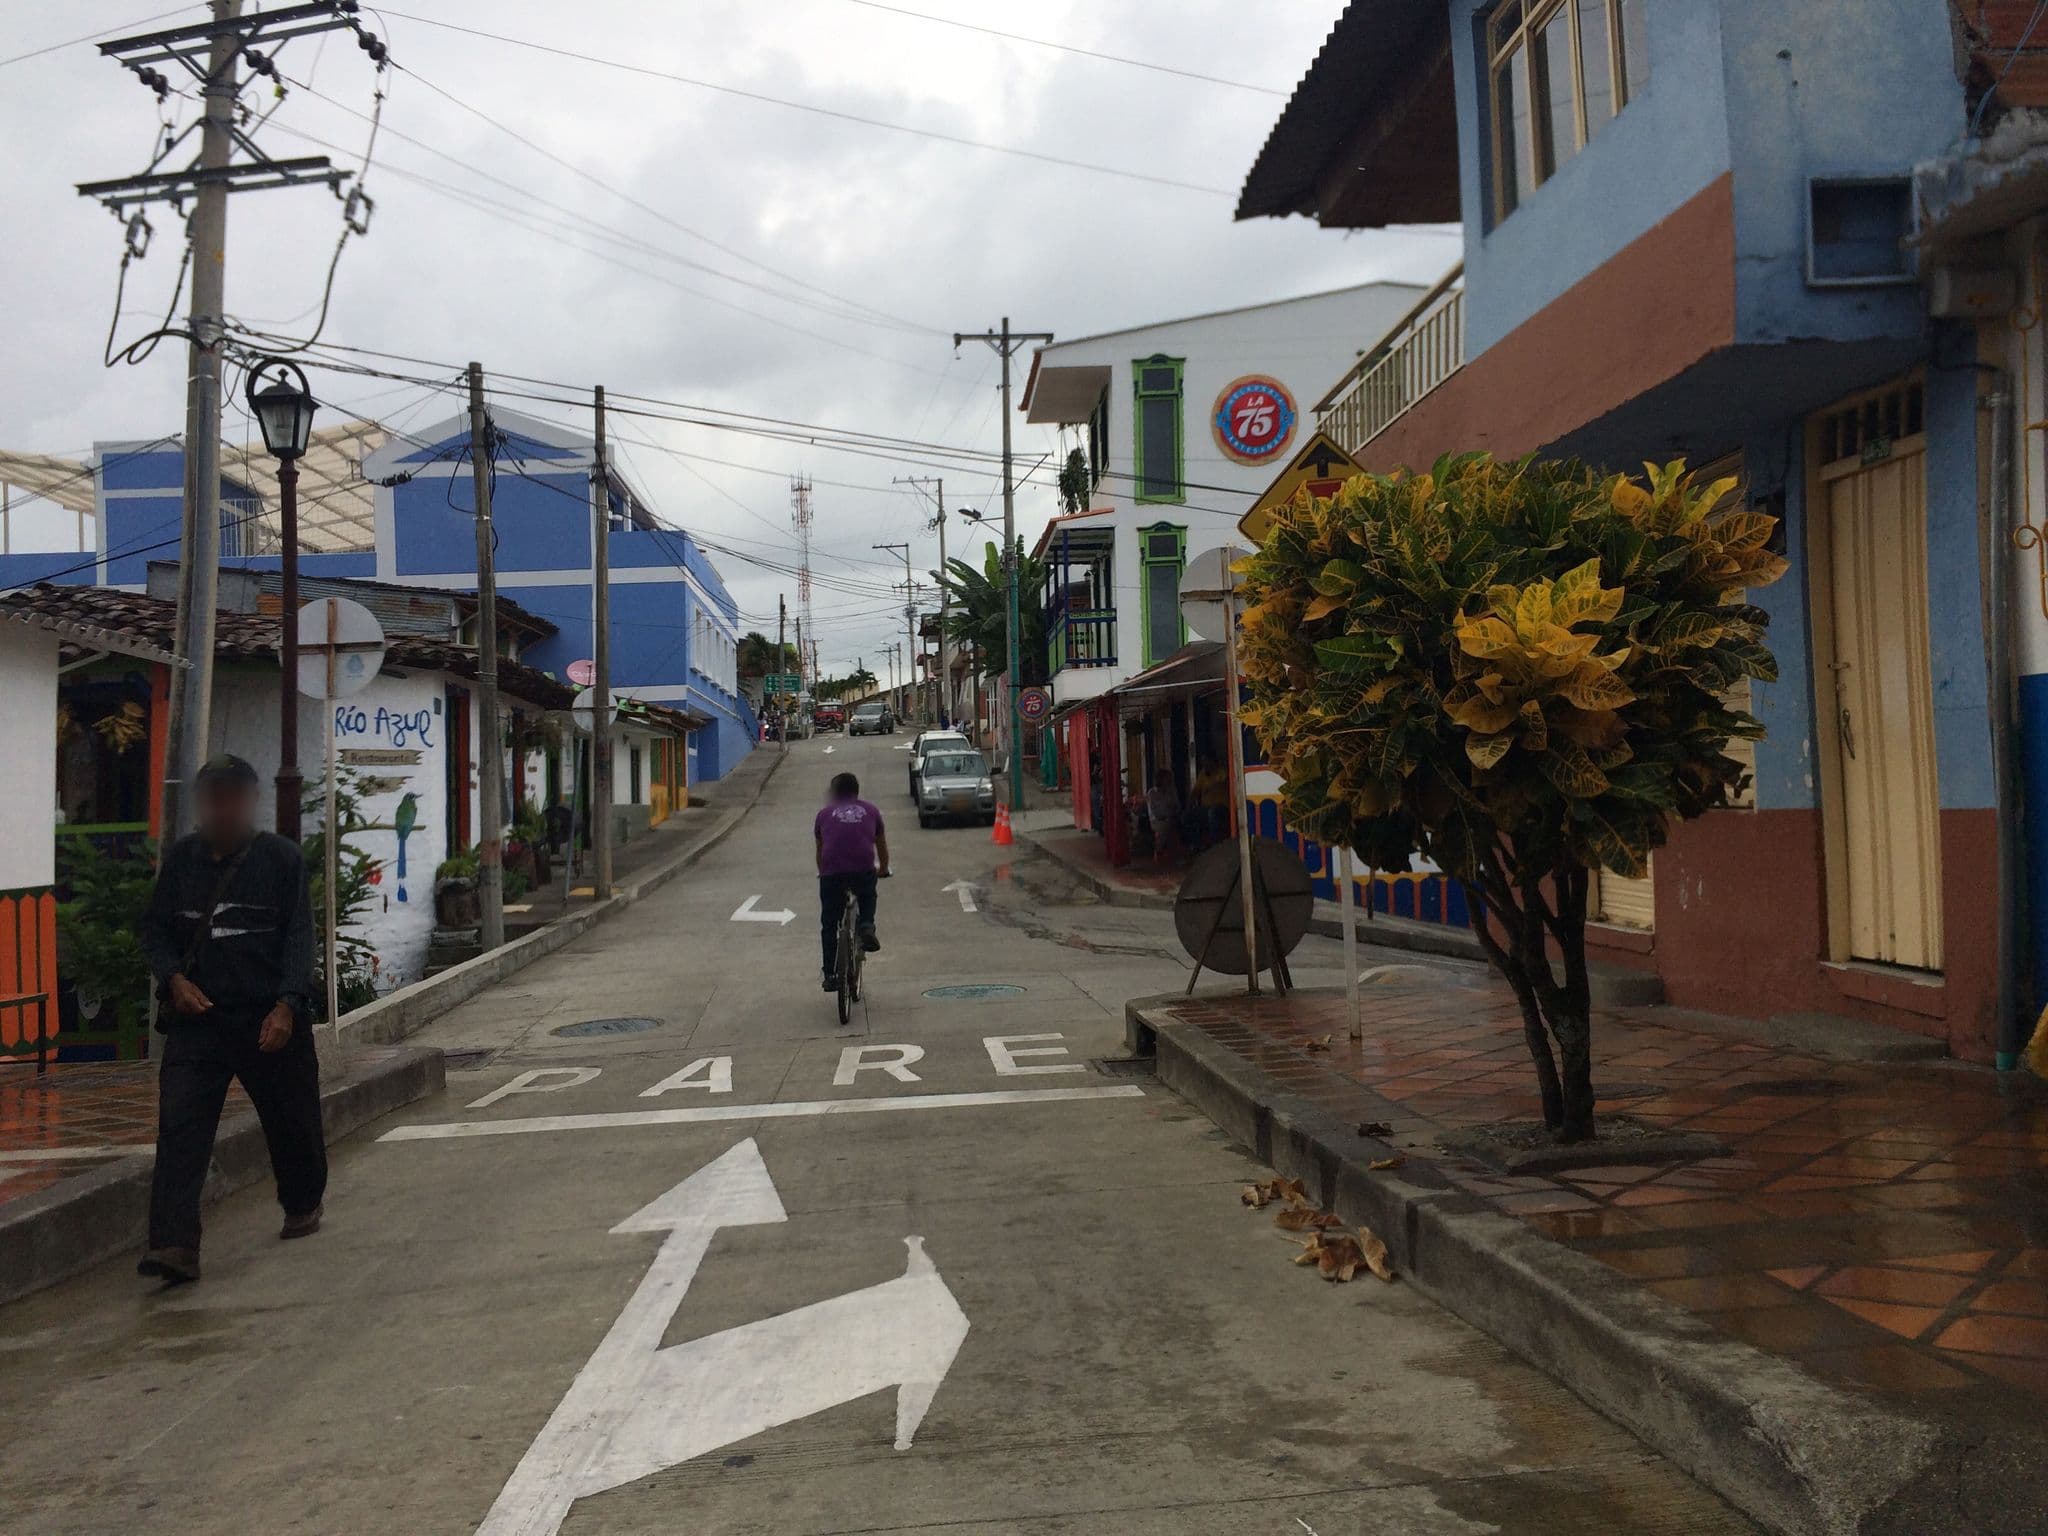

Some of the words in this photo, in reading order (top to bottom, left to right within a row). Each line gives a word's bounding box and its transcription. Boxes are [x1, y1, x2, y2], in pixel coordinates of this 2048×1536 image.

[1247, 396, 1264, 406] LA
[1235, 405, 1275, 438] 75
[335, 705, 366, 738] Río
[374, 707, 434, 748] Azul
[465, 1032, 1087, 1108] PARE
